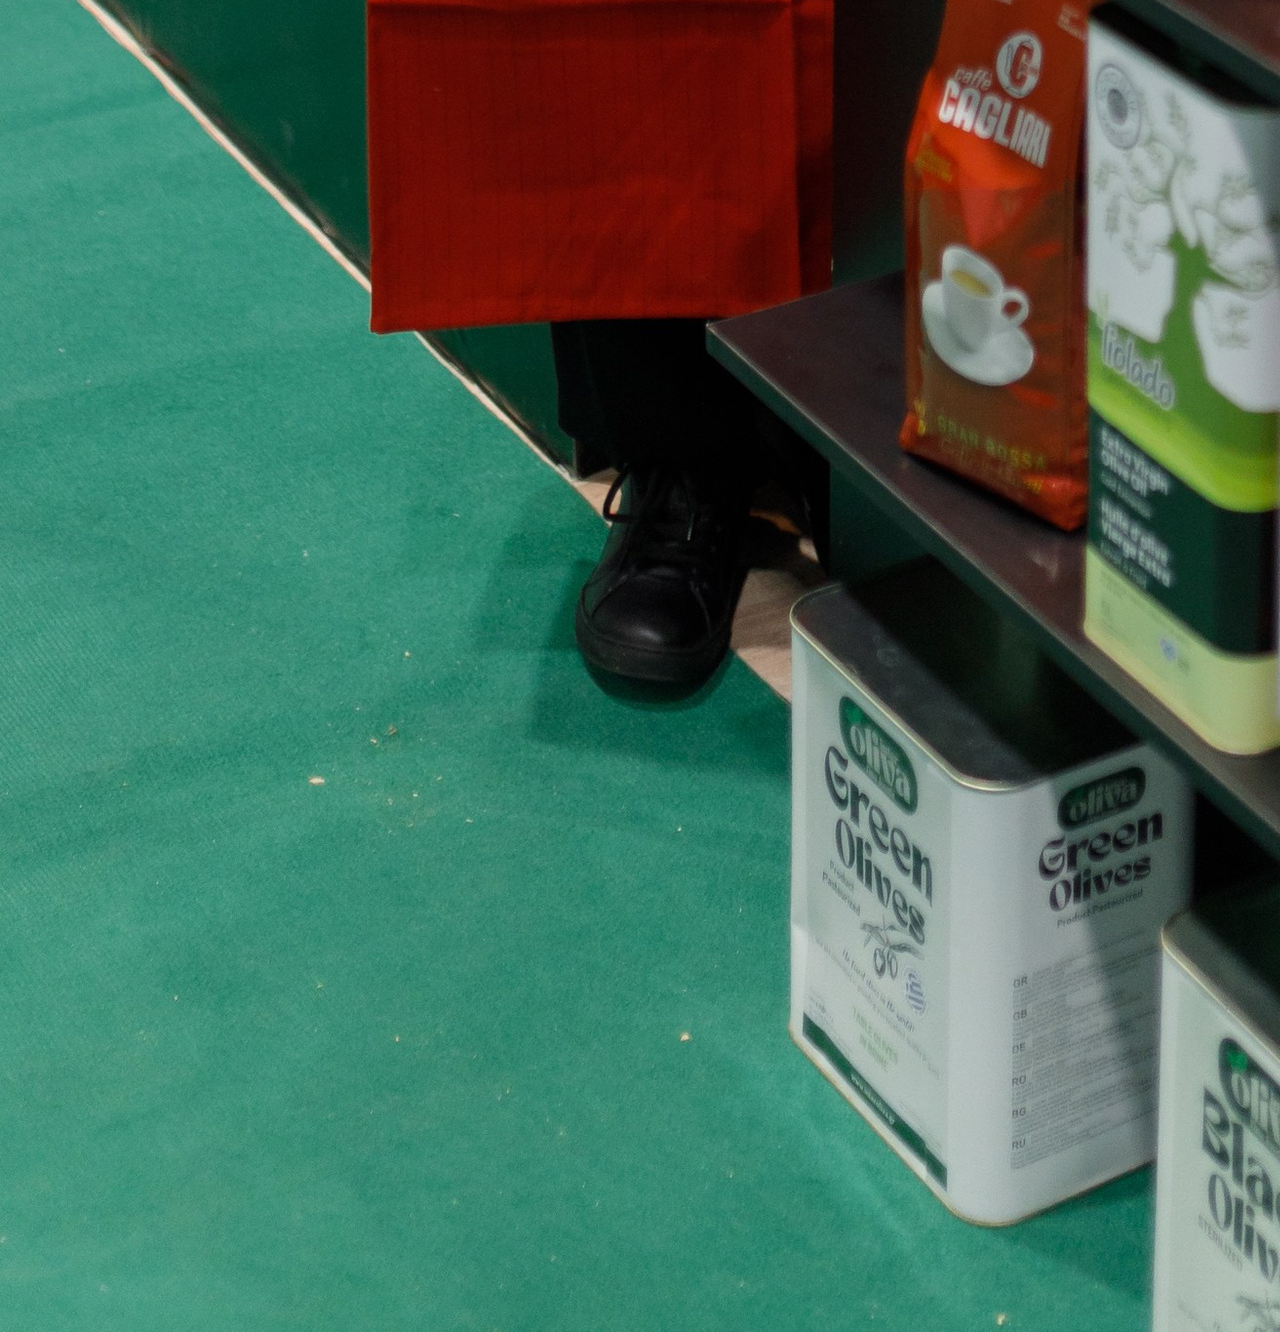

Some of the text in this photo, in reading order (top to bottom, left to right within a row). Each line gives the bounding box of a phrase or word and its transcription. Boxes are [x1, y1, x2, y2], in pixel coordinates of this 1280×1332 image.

[938, 77, 1051, 169] CAGLIARI
[850, 724, 911, 806] oliva
[1069, 779, 1138, 822] oliva
[825, 745, 933, 909] Green
[1039, 812, 1163, 881] Green
[836, 818, 925, 946] Olives
[1050, 857, 1151, 911] Olives
